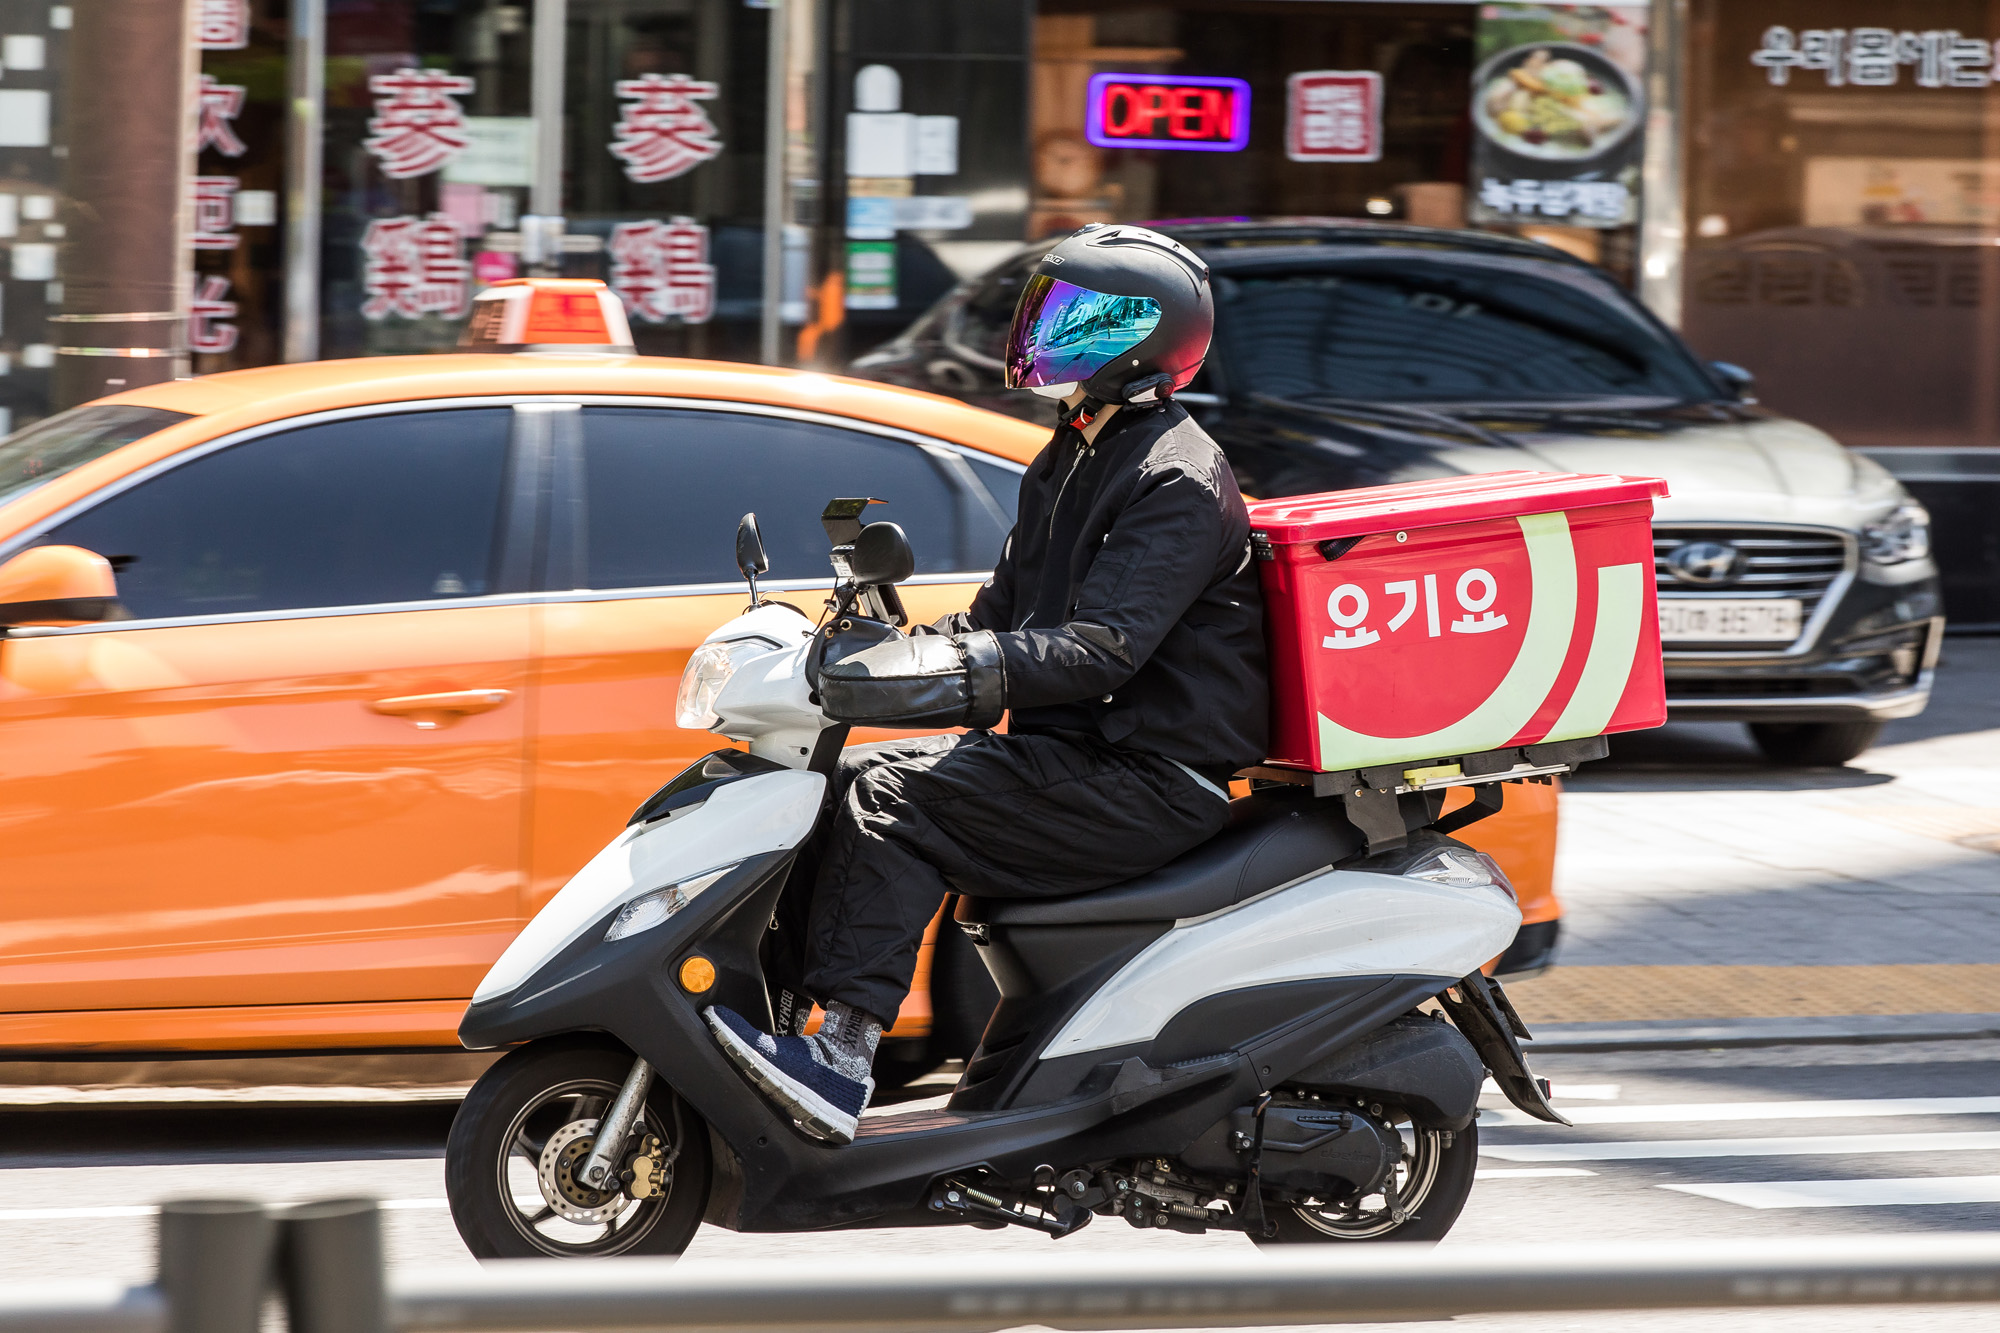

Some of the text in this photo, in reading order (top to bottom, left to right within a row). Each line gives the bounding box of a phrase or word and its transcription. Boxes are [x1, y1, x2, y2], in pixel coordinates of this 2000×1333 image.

[1103, 84, 1236, 139] OPEN
[1322, 568, 1509, 650] 요기요
[776, 988, 794, 1037] BBMAX
[843, 1007, 865, 1049] BBMAX
